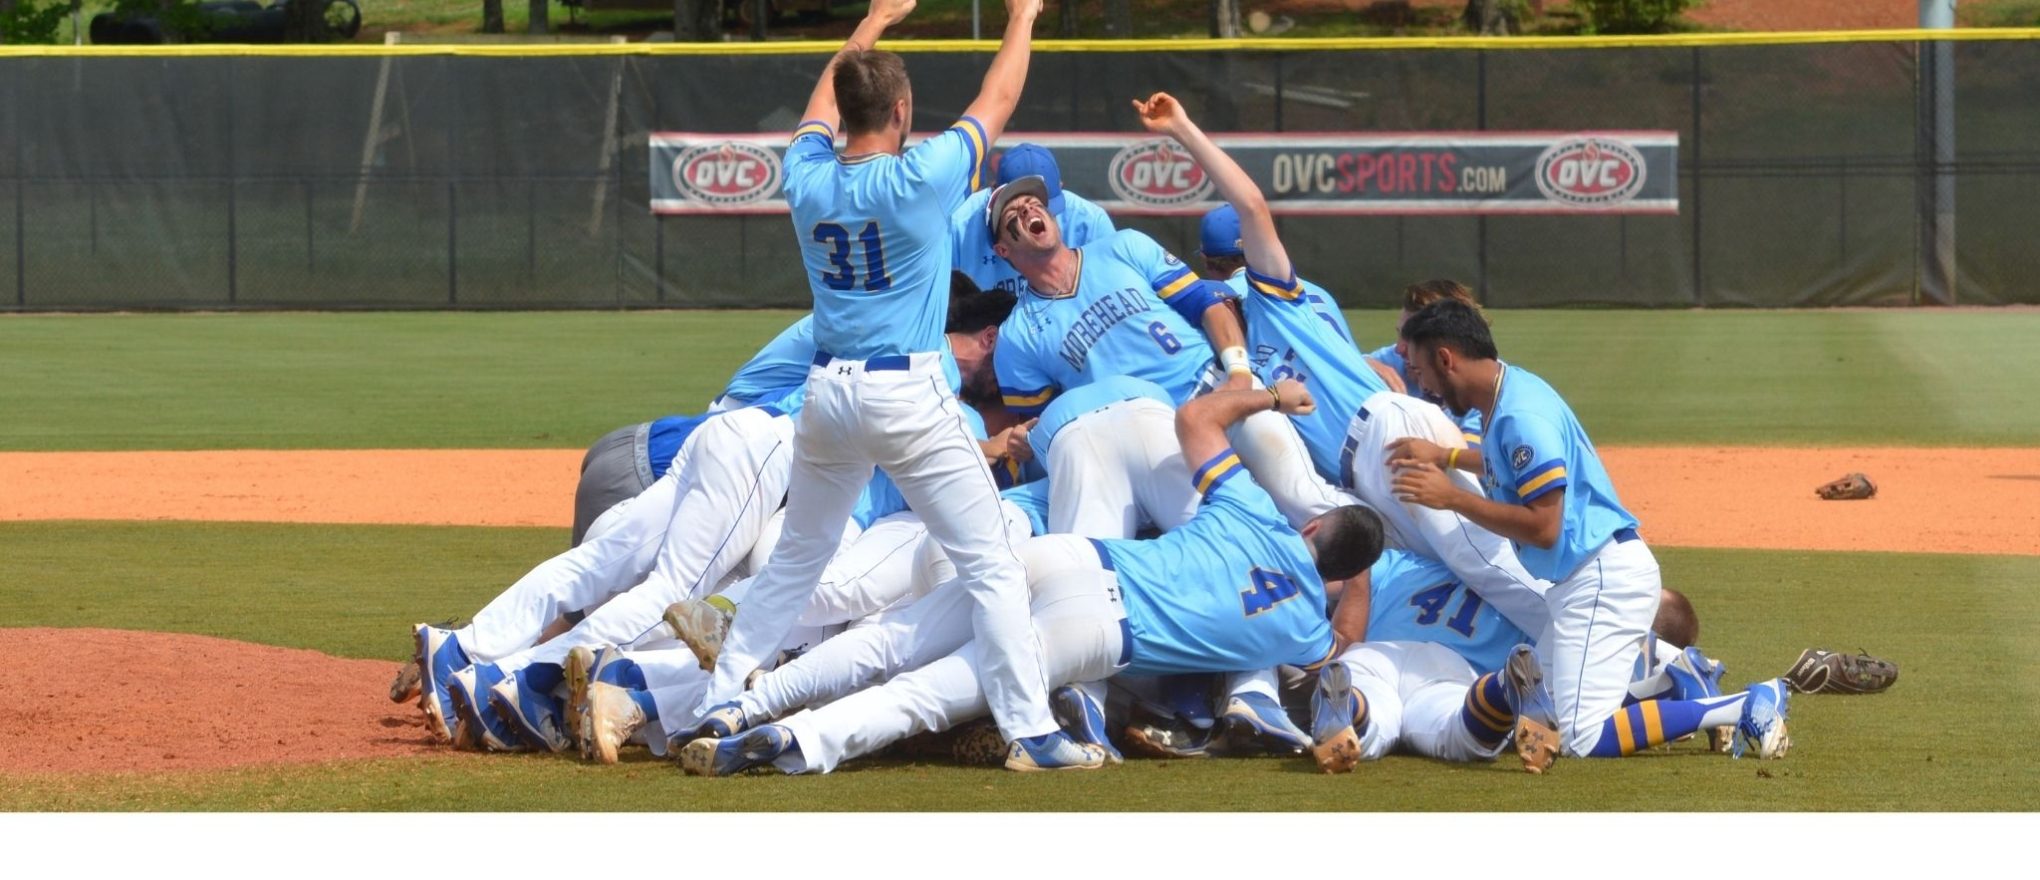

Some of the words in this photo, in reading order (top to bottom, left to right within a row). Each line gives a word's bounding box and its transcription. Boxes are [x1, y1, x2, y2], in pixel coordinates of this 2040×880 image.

[696, 160, 756, 187] OVC
[1132, 161, 1193, 187] OVC
[1272, 153, 1506, 193] OVCSPORTS.COM
[1558, 160, 1620, 187] OVC
[812, 220, 893, 291] 31
[1058, 287, 1151, 373] MOREHEAD
[1147, 321, 1183, 355] 6
[1240, 564, 1299, 619] 4
[1408, 581, 1482, 638] 41
